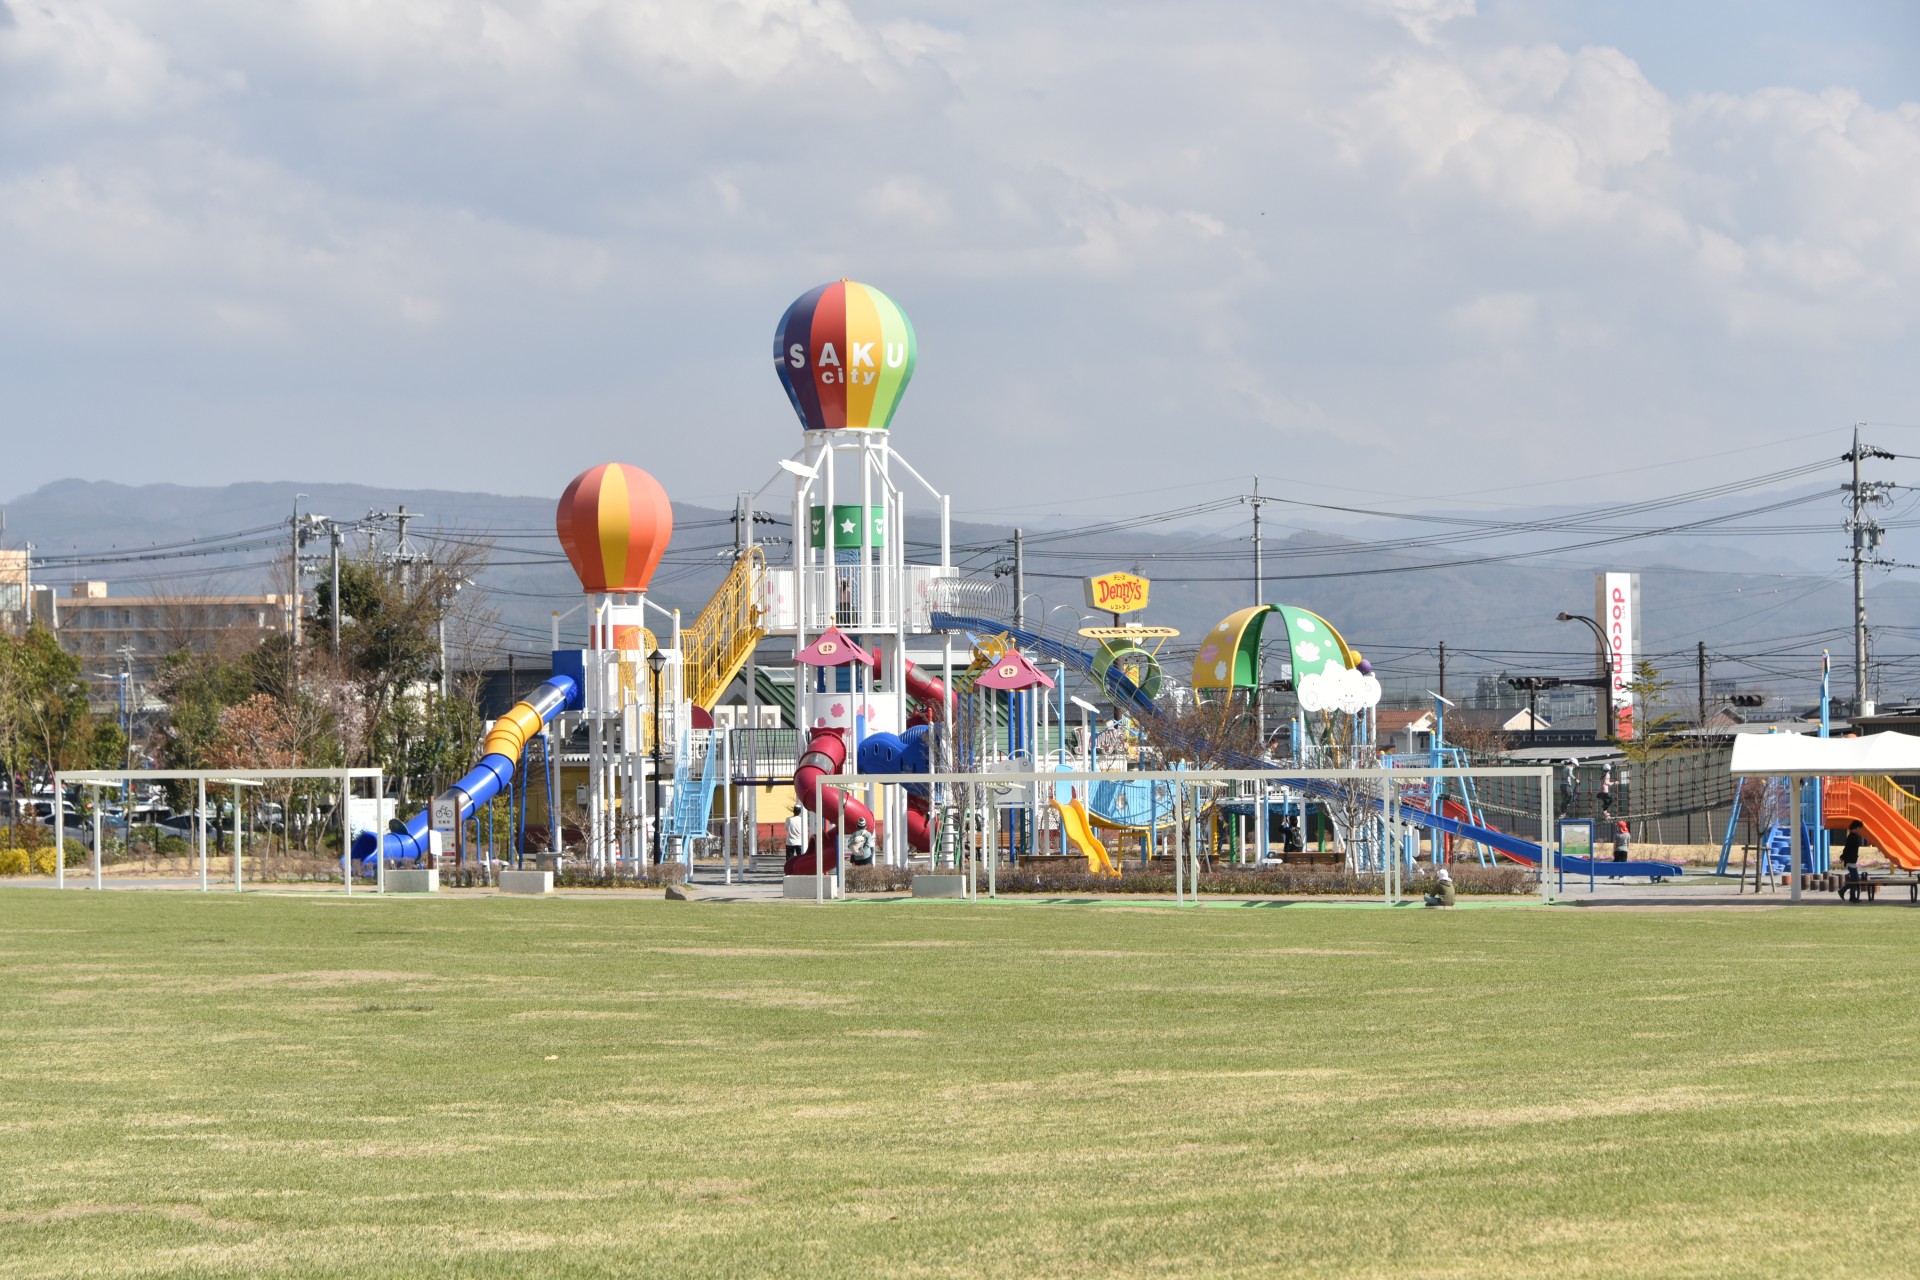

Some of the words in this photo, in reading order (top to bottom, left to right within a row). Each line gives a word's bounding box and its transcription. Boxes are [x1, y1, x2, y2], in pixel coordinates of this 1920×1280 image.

[789, 342, 904, 369] SAKU
[822, 368, 875, 384] city
[1098, 579, 1141, 604] Denny's
[1612, 588, 1625, 691] docomo
